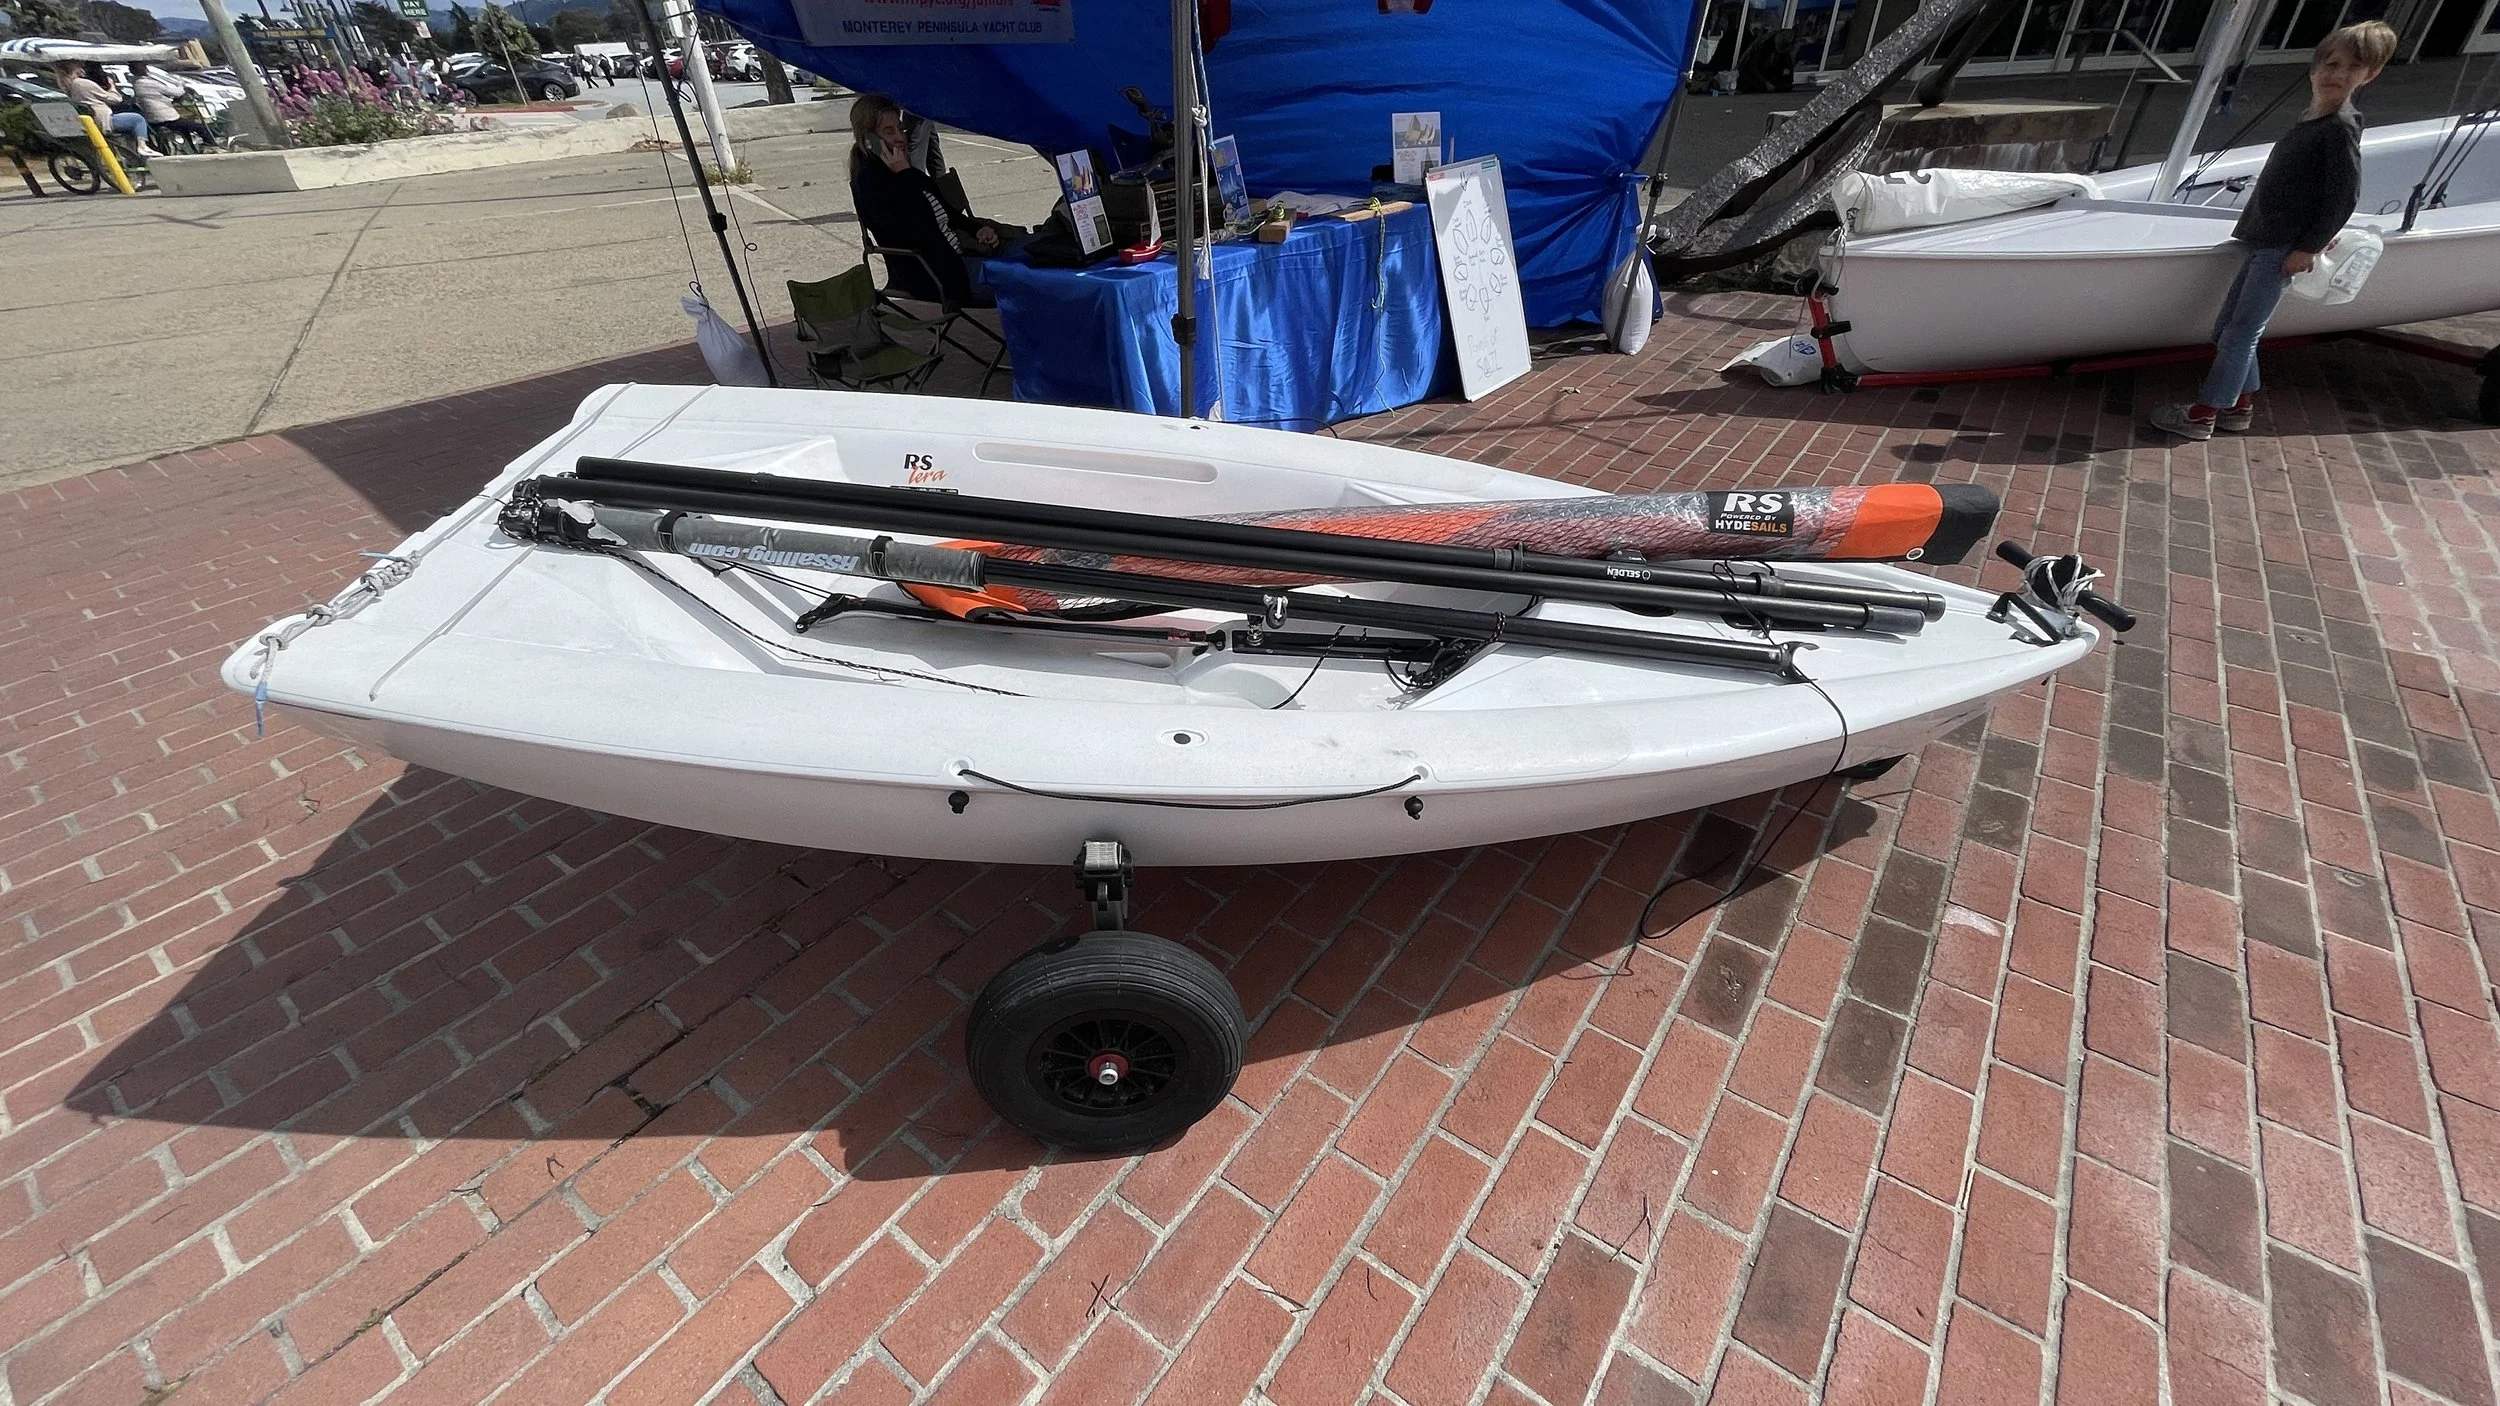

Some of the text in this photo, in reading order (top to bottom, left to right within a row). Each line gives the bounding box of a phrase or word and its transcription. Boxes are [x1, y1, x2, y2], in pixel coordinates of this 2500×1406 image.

[404, 8, 427, 16] HERE
[843, 20, 1043, 33] MONTEREY PENINSULA YACHT CLUB
[904, 453, 933, 471] RS
[1723, 492, 1784, 514] RS
[689, 543, 860, 572] RSsailing.com
